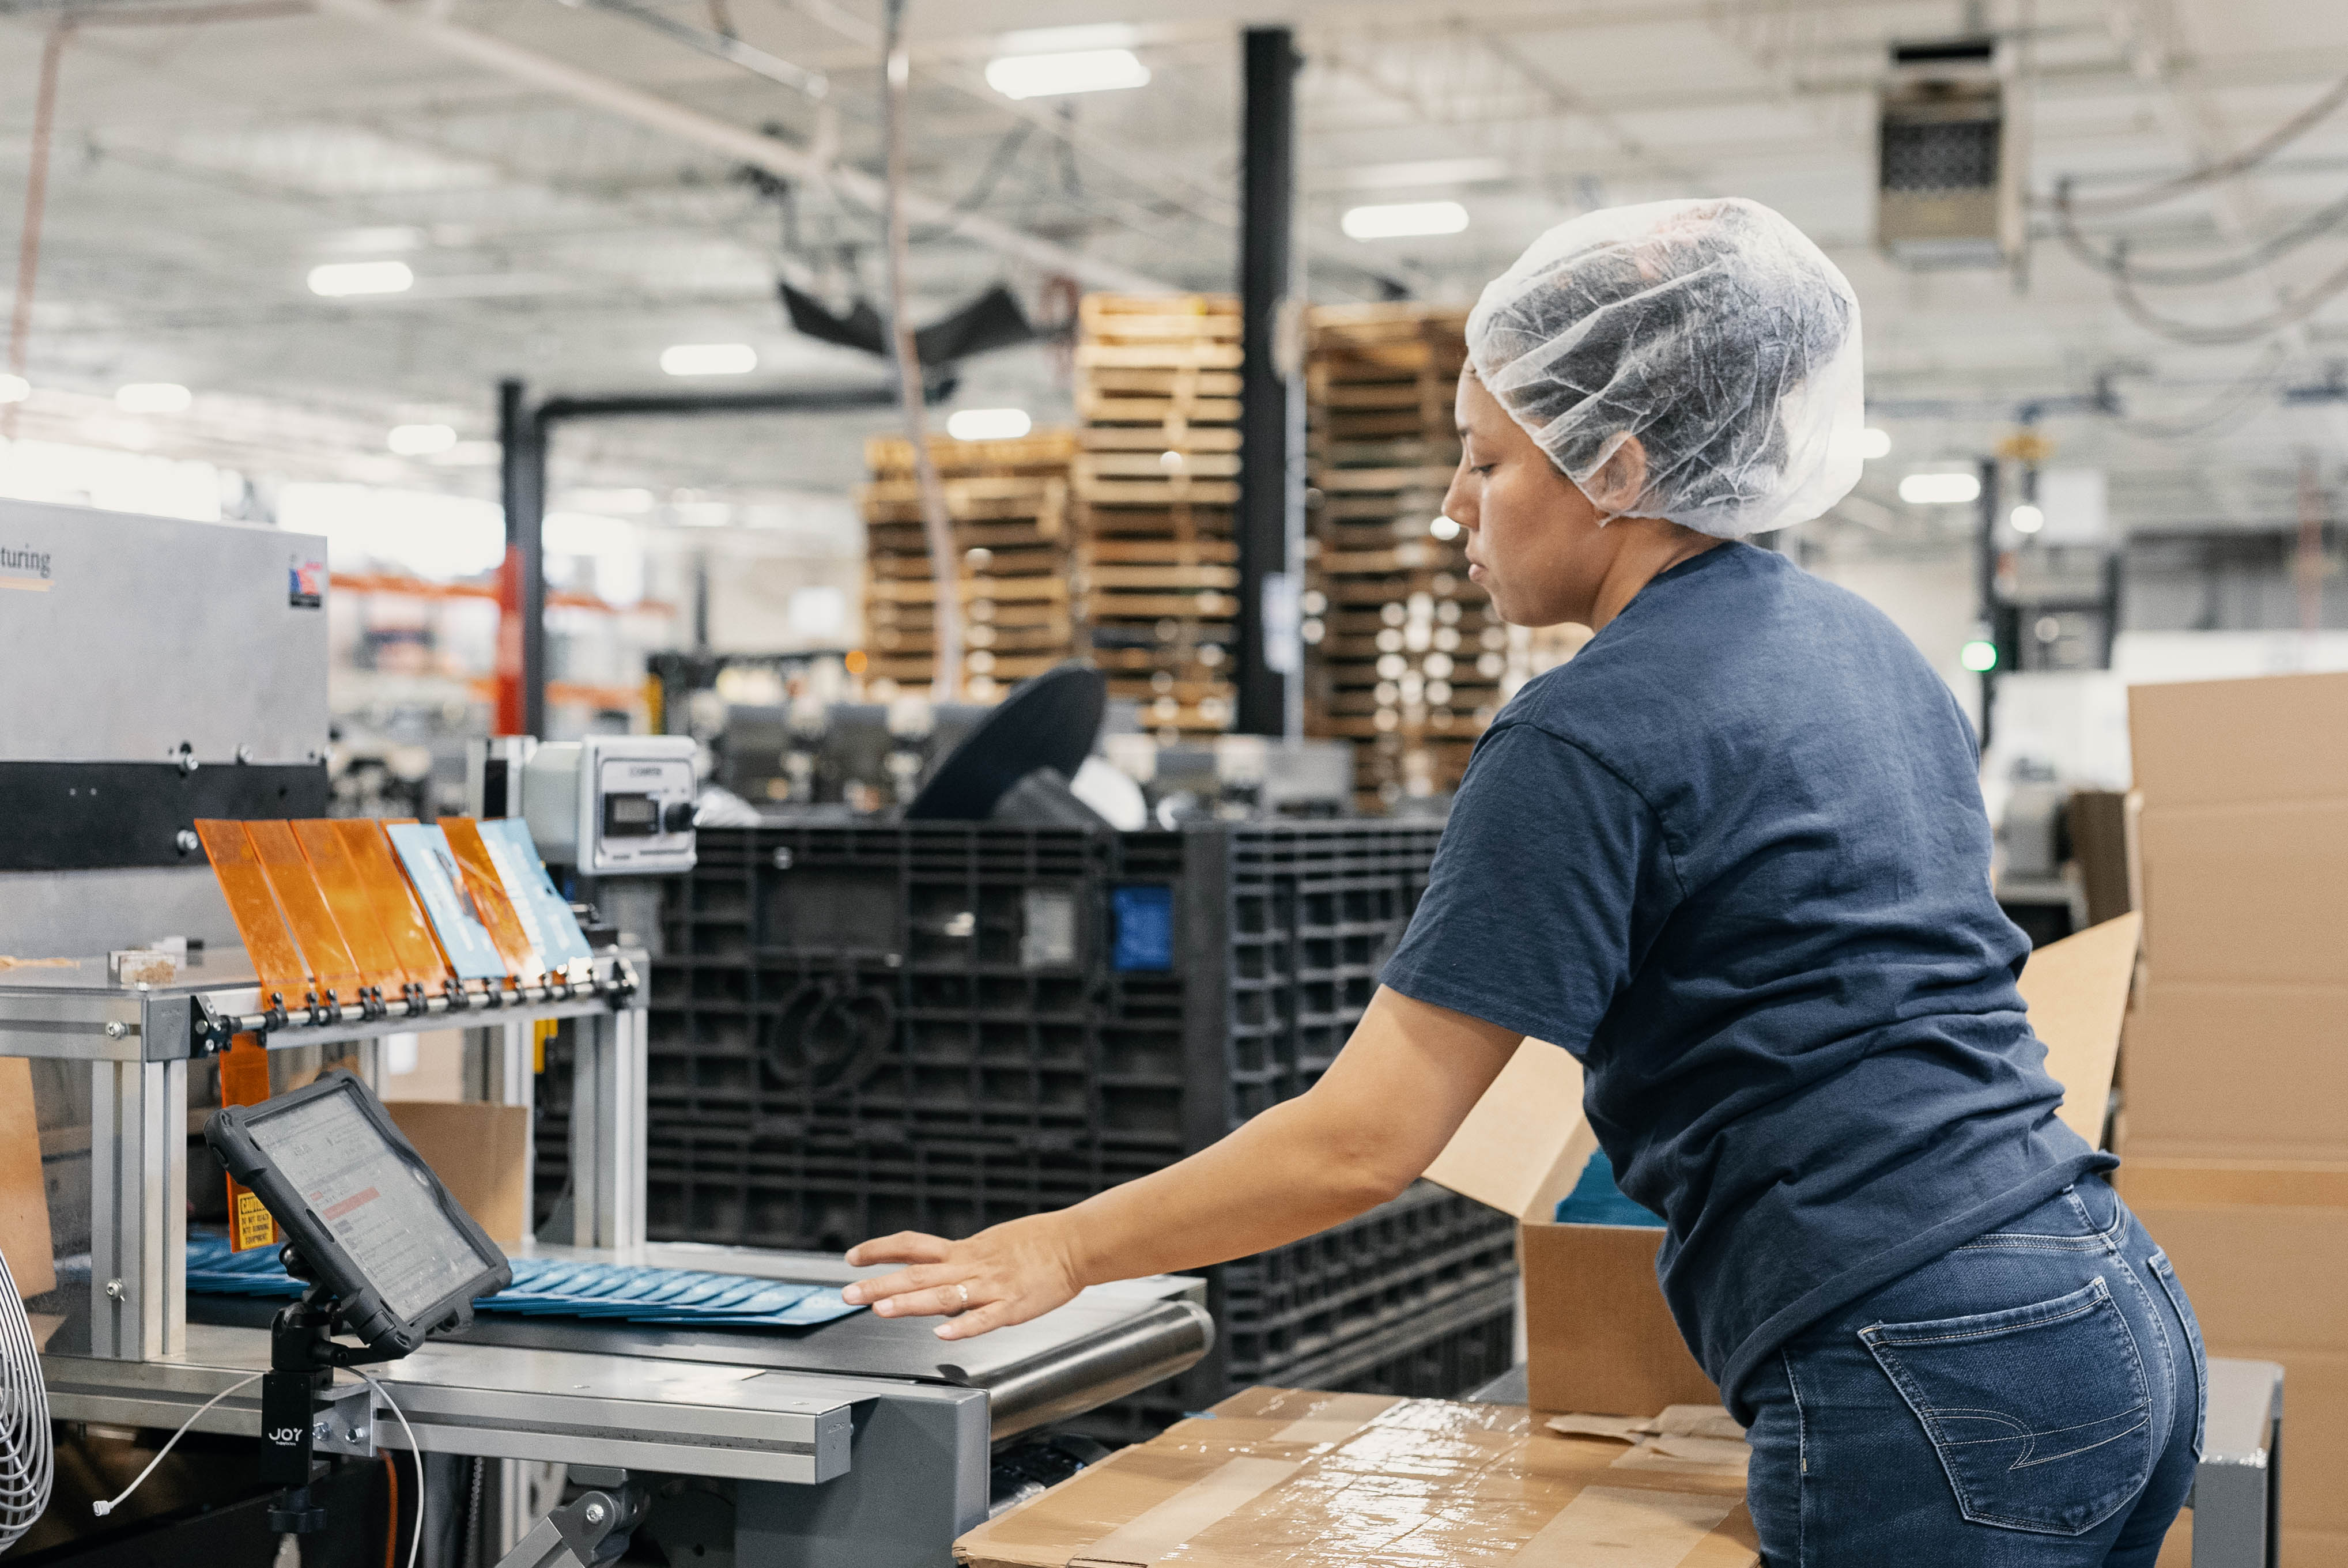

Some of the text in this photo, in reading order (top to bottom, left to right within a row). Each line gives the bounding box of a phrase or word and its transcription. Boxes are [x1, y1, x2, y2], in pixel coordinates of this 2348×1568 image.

[0, 543, 51, 577] turing
[241, 1196, 266, 1214] CAUTI
[269, 1428, 303, 1441] JOY
